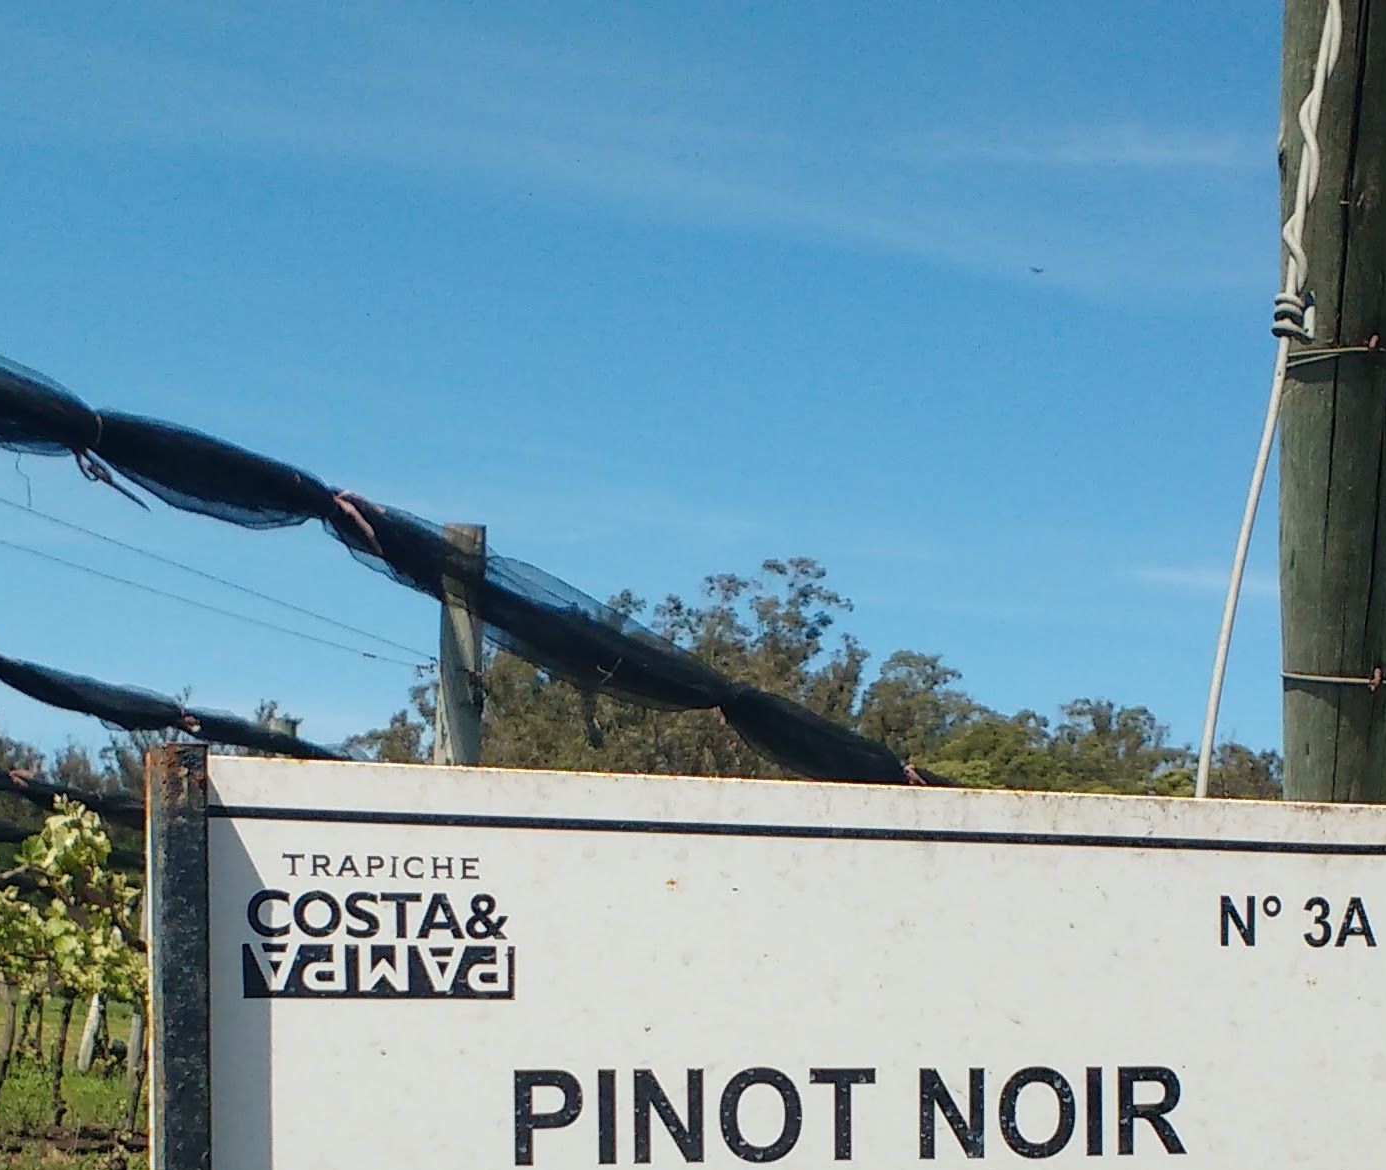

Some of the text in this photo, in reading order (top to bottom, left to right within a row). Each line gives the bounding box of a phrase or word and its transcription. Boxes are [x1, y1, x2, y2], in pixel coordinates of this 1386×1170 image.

[282, 853, 480, 880] TRAPICHE
[1220, 895, 1377, 948] N° 3A
[245, 942, 514, 994] PAMPA
[513, 1066, 1188, 1167] PINOT NOIR
